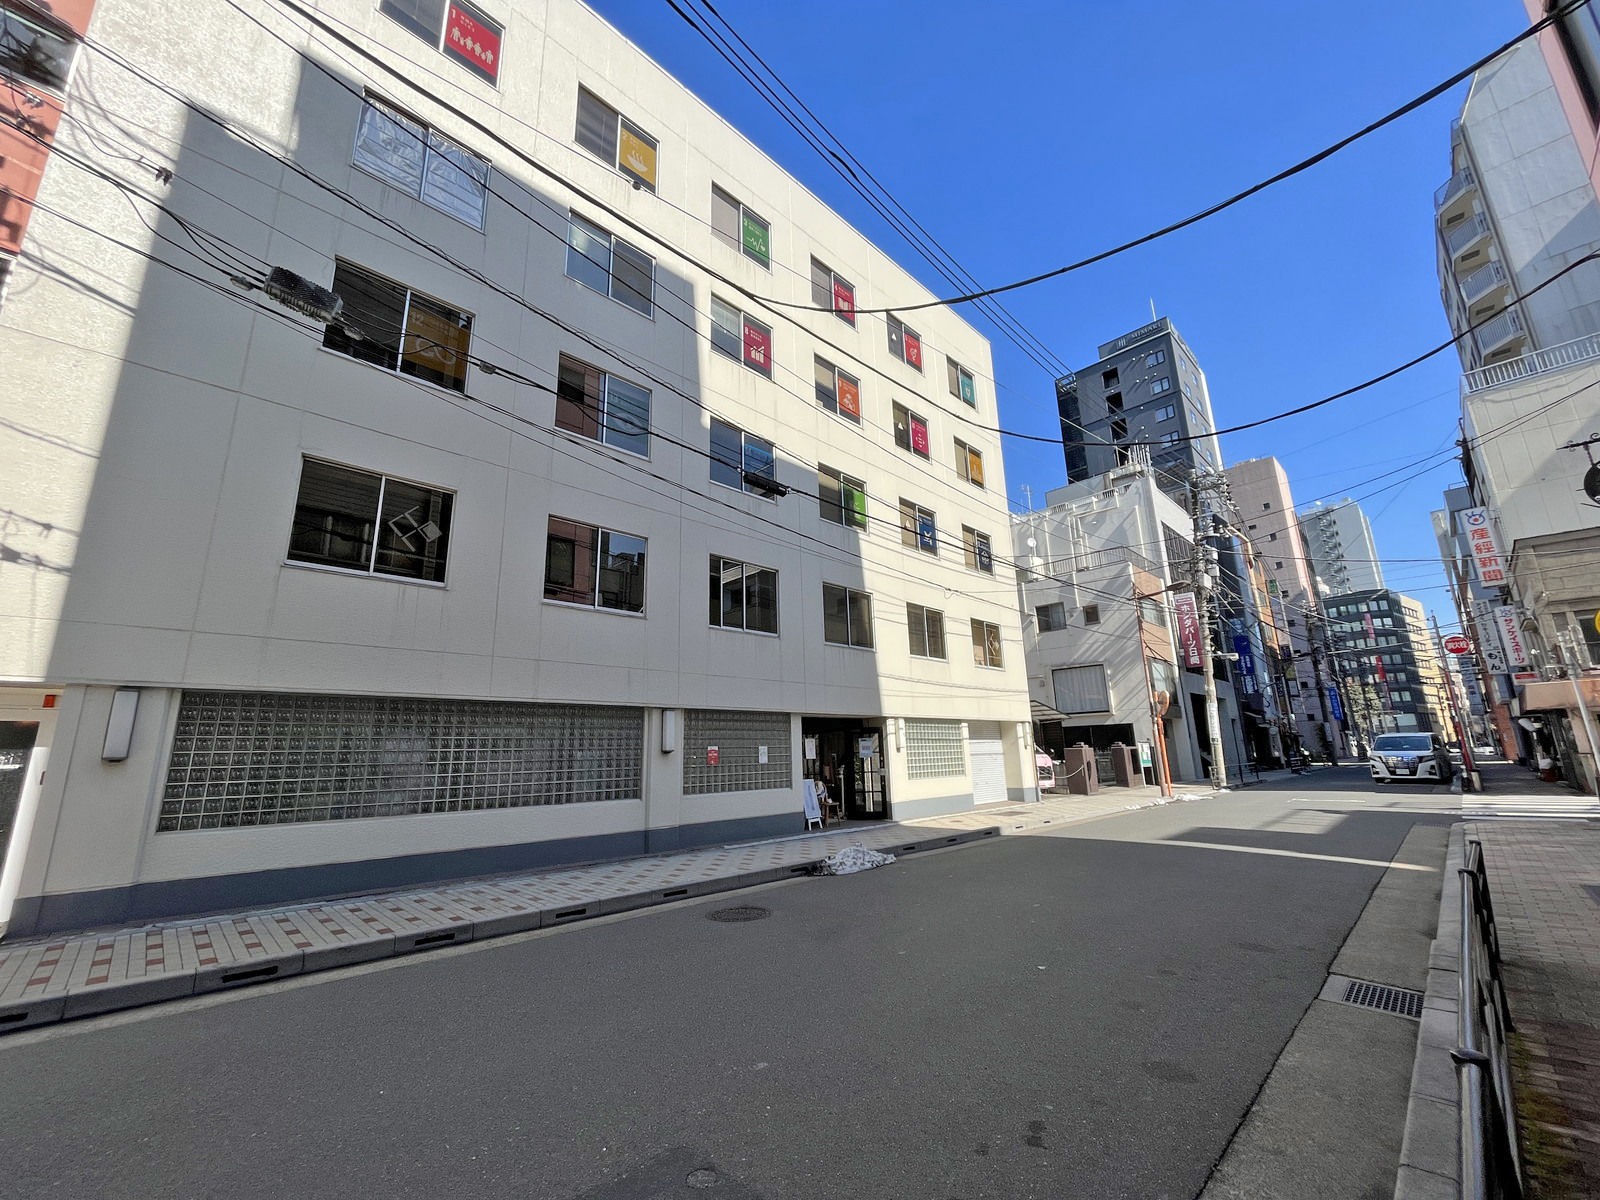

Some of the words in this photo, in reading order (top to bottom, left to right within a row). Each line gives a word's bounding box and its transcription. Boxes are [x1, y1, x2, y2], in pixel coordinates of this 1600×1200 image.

[744, 326, 749, 335] 8
[1447, 641, 1468, 650] 消火栓
[1504, 618, 1525, 664] サンケイスポーツ
